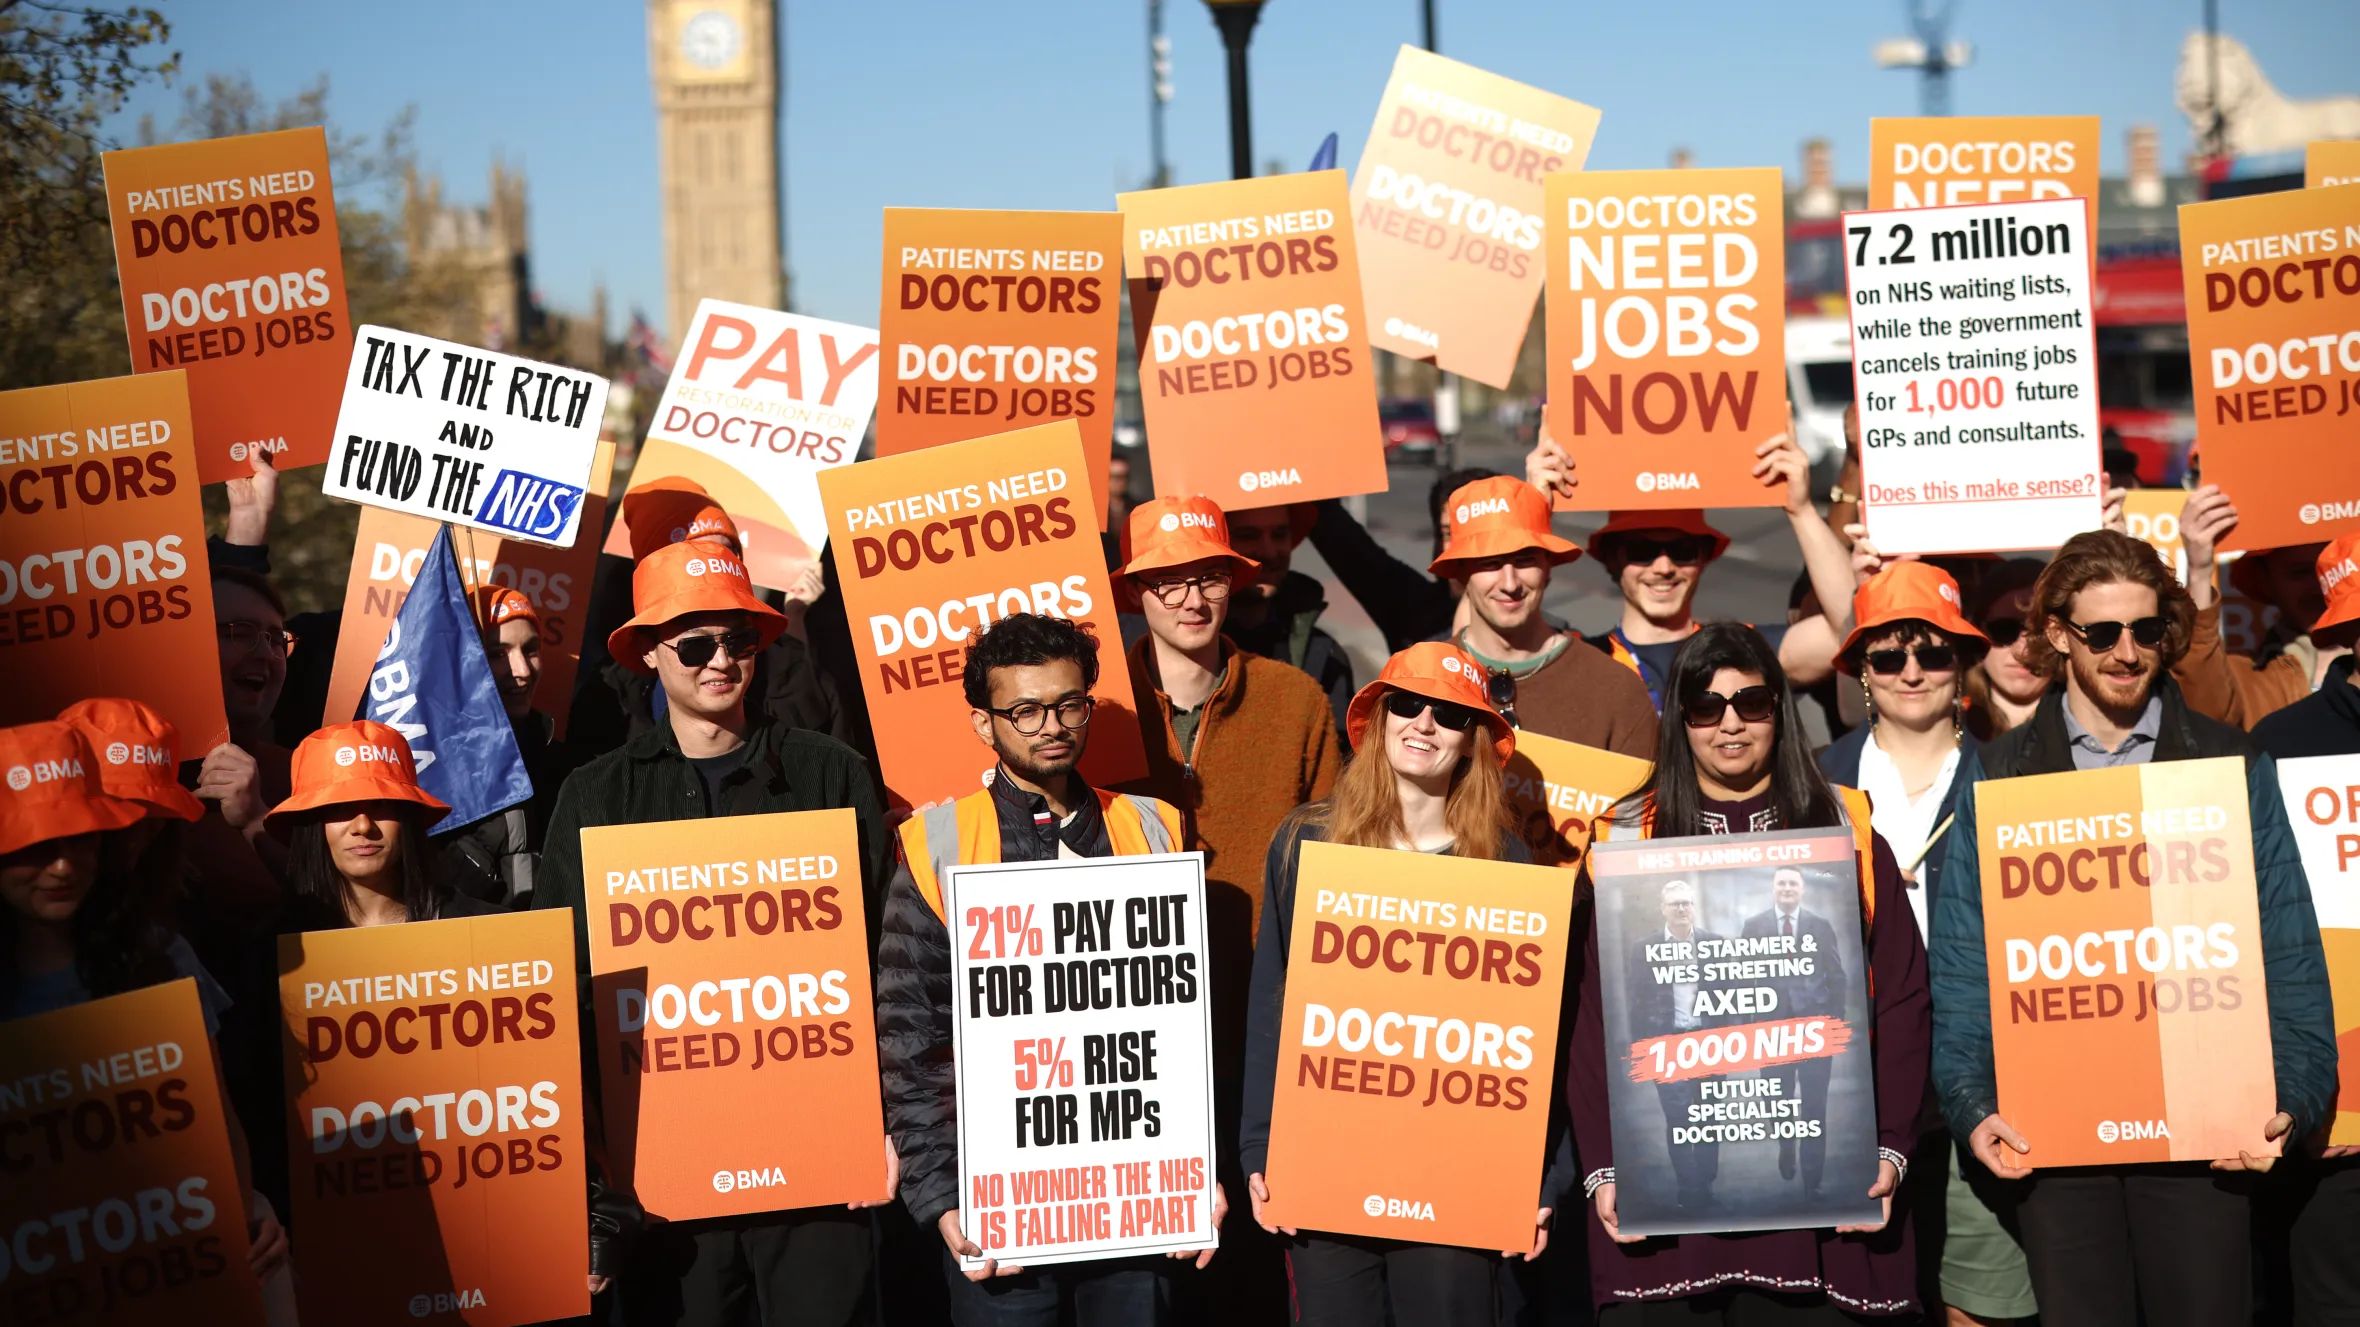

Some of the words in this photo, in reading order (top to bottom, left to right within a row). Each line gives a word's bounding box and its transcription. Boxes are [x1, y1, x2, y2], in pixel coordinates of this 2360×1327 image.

[1402, 83, 1508, 133] PATIENTS
[1510, 117, 1572, 154] NEED
[1390, 106, 1565, 185] DOCTORS
[1894, 141, 2076, 174] DOCTORS
[127, 179, 244, 214] PATIENTS
[250, 170, 315, 196] NEED
[1368, 165, 1544, 249] DOCTORS
[1567, 194, 1758, 230] DOCTORS
[132, 196, 320, 258] DOCTORS
[1139, 217, 1260, 250] PATIENTS
[1263, 208, 1335, 236] NEED
[1358, 201, 1447, 250] NEED
[1448, 234, 1530, 280] JOBS
[1848, 223, 1914, 268] 7.2
[1931, 216, 2072, 264] million
[2202, 228, 2337, 267] PATIENTS
[901, 247, 1025, 271] PATIENTS
[1032, 250, 1103, 272] NEED
[1144, 235, 1338, 291] DOCTORS
[1569, 233, 1759, 291] NEED
[141, 268, 330, 332] DOCTORS
[900, 274, 1101, 314] DOCTORS
[1855, 286, 1881, 306] on
[1887, 281, 1933, 303] NHS
[1939, 276, 2016, 302] waiting
[2021, 273, 2072, 301] lists,
[148, 322, 246, 368] NEED
[254, 311, 335, 357] JOBS
[1151, 304, 1350, 363] DOCTORS
[1401, 324, 1438, 348] BMA
[1571, 294, 1761, 372] JOBS
[1857, 318, 1912, 341] while
[1918, 315, 1952, 337] the
[1958, 308, 2083, 340] government
[360, 336, 431, 399] TAX
[441, 353, 496, 410] THE
[507, 367, 591, 429] RICH
[684, 313, 879, 407] PAY
[897, 344, 1098, 384] DOCTORS
[1159, 358, 1259, 398] NEED
[1268, 346, 1353, 390] JOBS
[1861, 351, 1940, 375] cancels
[1946, 346, 2029, 373] training
[2034, 344, 2077, 372] jobs
[676, 385, 811, 423] RESTORATION
[816, 412, 855, 431] FOR
[896, 386, 998, 415] NEED
[1006, 388, 1095, 422] JOBS
[1572, 370, 1759, 436] NOW
[1866, 389, 1897, 412] for
[1904, 375, 2004, 421] 1,000
[2016, 378, 2079, 402] future
[2215, 384, 2327, 425] NEED
[87, 420, 171, 453] NEED
[438, 419, 493, 451] AND
[663, 405, 846, 464] DOCTORS
[1866, 426, 1906, 450] GPs
[1914, 423, 1952, 446] and
[1958, 419, 2085, 444] consultants.
[0, 451, 176, 518] CTORS
[340, 435, 423, 503] FUND
[427, 453, 484, 516] THE
[484, 474, 579, 536] NHS
[846, 486, 983, 533] PATIENTS
[987, 467, 1068, 504] NEED
[1259, 467, 1302, 488] BMA
[1657, 472, 1700, 490] BMA
[1868, 481, 1918, 504] Does
[1922, 478, 1959, 500] this
[1965, 476, 2021, 499] make
[2025, 474, 2096, 498] sense?
[688, 518, 724, 535] BMA
[1181, 513, 1216, 528] BMA
[1470, 498, 1510, 518] BMA
[2322, 500, 2360, 520] BMA
[852, 497, 1076, 579] DOCTORS
[370, 543, 572, 611] DOTORS
[708, 558, 745, 580] BMA
[2325, 558, 2359, 587] BMA
[87, 585, 191, 640] JOBS
[868, 575, 1094, 657] DOCTORS
[880, 646, 969, 695] NEE
[34, 758, 85, 783] BMA
[133, 745, 172, 767] BMA
[359, 745, 400, 764] BMA
[1504, 773, 1616, 815] PATIENT
[1997, 812, 2133, 850] PATIENTS
[2141, 806, 2227, 836] NEED
[606, 863, 749, 897] PATIENTS
[757, 855, 838, 883] NEED
[1638, 855, 1674, 869] NHS
[1678, 847, 1762, 867] TRAINING
[1767, 844, 1811, 859] CUTS
[1999, 838, 2230, 900] DOCTORS
[610, 885, 843, 948] DOCTORS
[965, 904, 1043, 960] 21%
[1053, 897, 1113, 954] PAY
[1125, 894, 1188, 948] CUT
[1315, 890, 1456, 929] PATIENTS
[1464, 905, 1548, 938] NEED
[1311, 921, 1543, 988] DOCTORS
[1645, 944, 1694, 962] KEIR
[1698, 936, 1796, 959] STARMER
[1801, 934, 1818, 952] &
[1653, 966, 1699, 985] WES
[1704, 958, 1814, 981] STREETING
[2005, 922, 2240, 983] DOCTORS
[305, 968, 458, 1008] PATIENTS
[466, 960, 554, 993] NEED
[616, 969, 851, 1033] DOCTORS
[968, 965, 1032, 1018] FOR
[1043, 952, 1197, 1011] DOCTORS
[1693, 987, 1778, 1017] AXED
[2009, 985, 2124, 1025] NEED
[2135, 974, 2243, 1021] JOBS
[306, 993, 556, 1062] DOCTORS
[620, 1033, 740, 1075] NEED
[752, 1021, 854, 1071] JOBS
[1301, 1003, 1535, 1071] DOCTORS
[1649, 1032, 1747, 1078] 1,000
[1753, 1021, 1826, 1060] NHS
[81, 1042, 183, 1090] NEED
[1014, 1035, 1073, 1091] 5%
[1083, 1030, 1158, 1086] RISE
[1298, 1053, 1416, 1100] NEED
[1422, 1066, 1529, 1112] JOBS
[1688, 1100, 1802, 1122] SPECIALIST
[1700, 1078, 1782, 1100] FUTURE
[312, 1082, 561, 1154] DOCTORS
[1015, 1094, 1079, 1148] FOR
[1090, 1088, 1161, 1142] MPs
[1673, 1123, 1766, 1144] DOCTORS
[1770, 1120, 1821, 1140] JOBS
[2121, 1119, 2170, 1142] BMA
[314, 1151, 443, 1200] NEED
[453, 1134, 563, 1188] JOBS
[737, 1167, 786, 1189] BMA
[972, 1173, 1003, 1209] NO
[1010, 1165, 1108, 1207] WONDER
[1113, 1161, 1156, 1197] THE
[1159, 1157, 1204, 1193] NHS
[979, 1213, 1009, 1251] IS
[1014, 1202, 1113, 1248] FALLING
[1118, 1194, 1198, 1238] APART
[1386, 1198, 1435, 1223] BMA
[102, 1236, 226, 1310] JOBS
[433, 1289, 486, 1311] BMA
